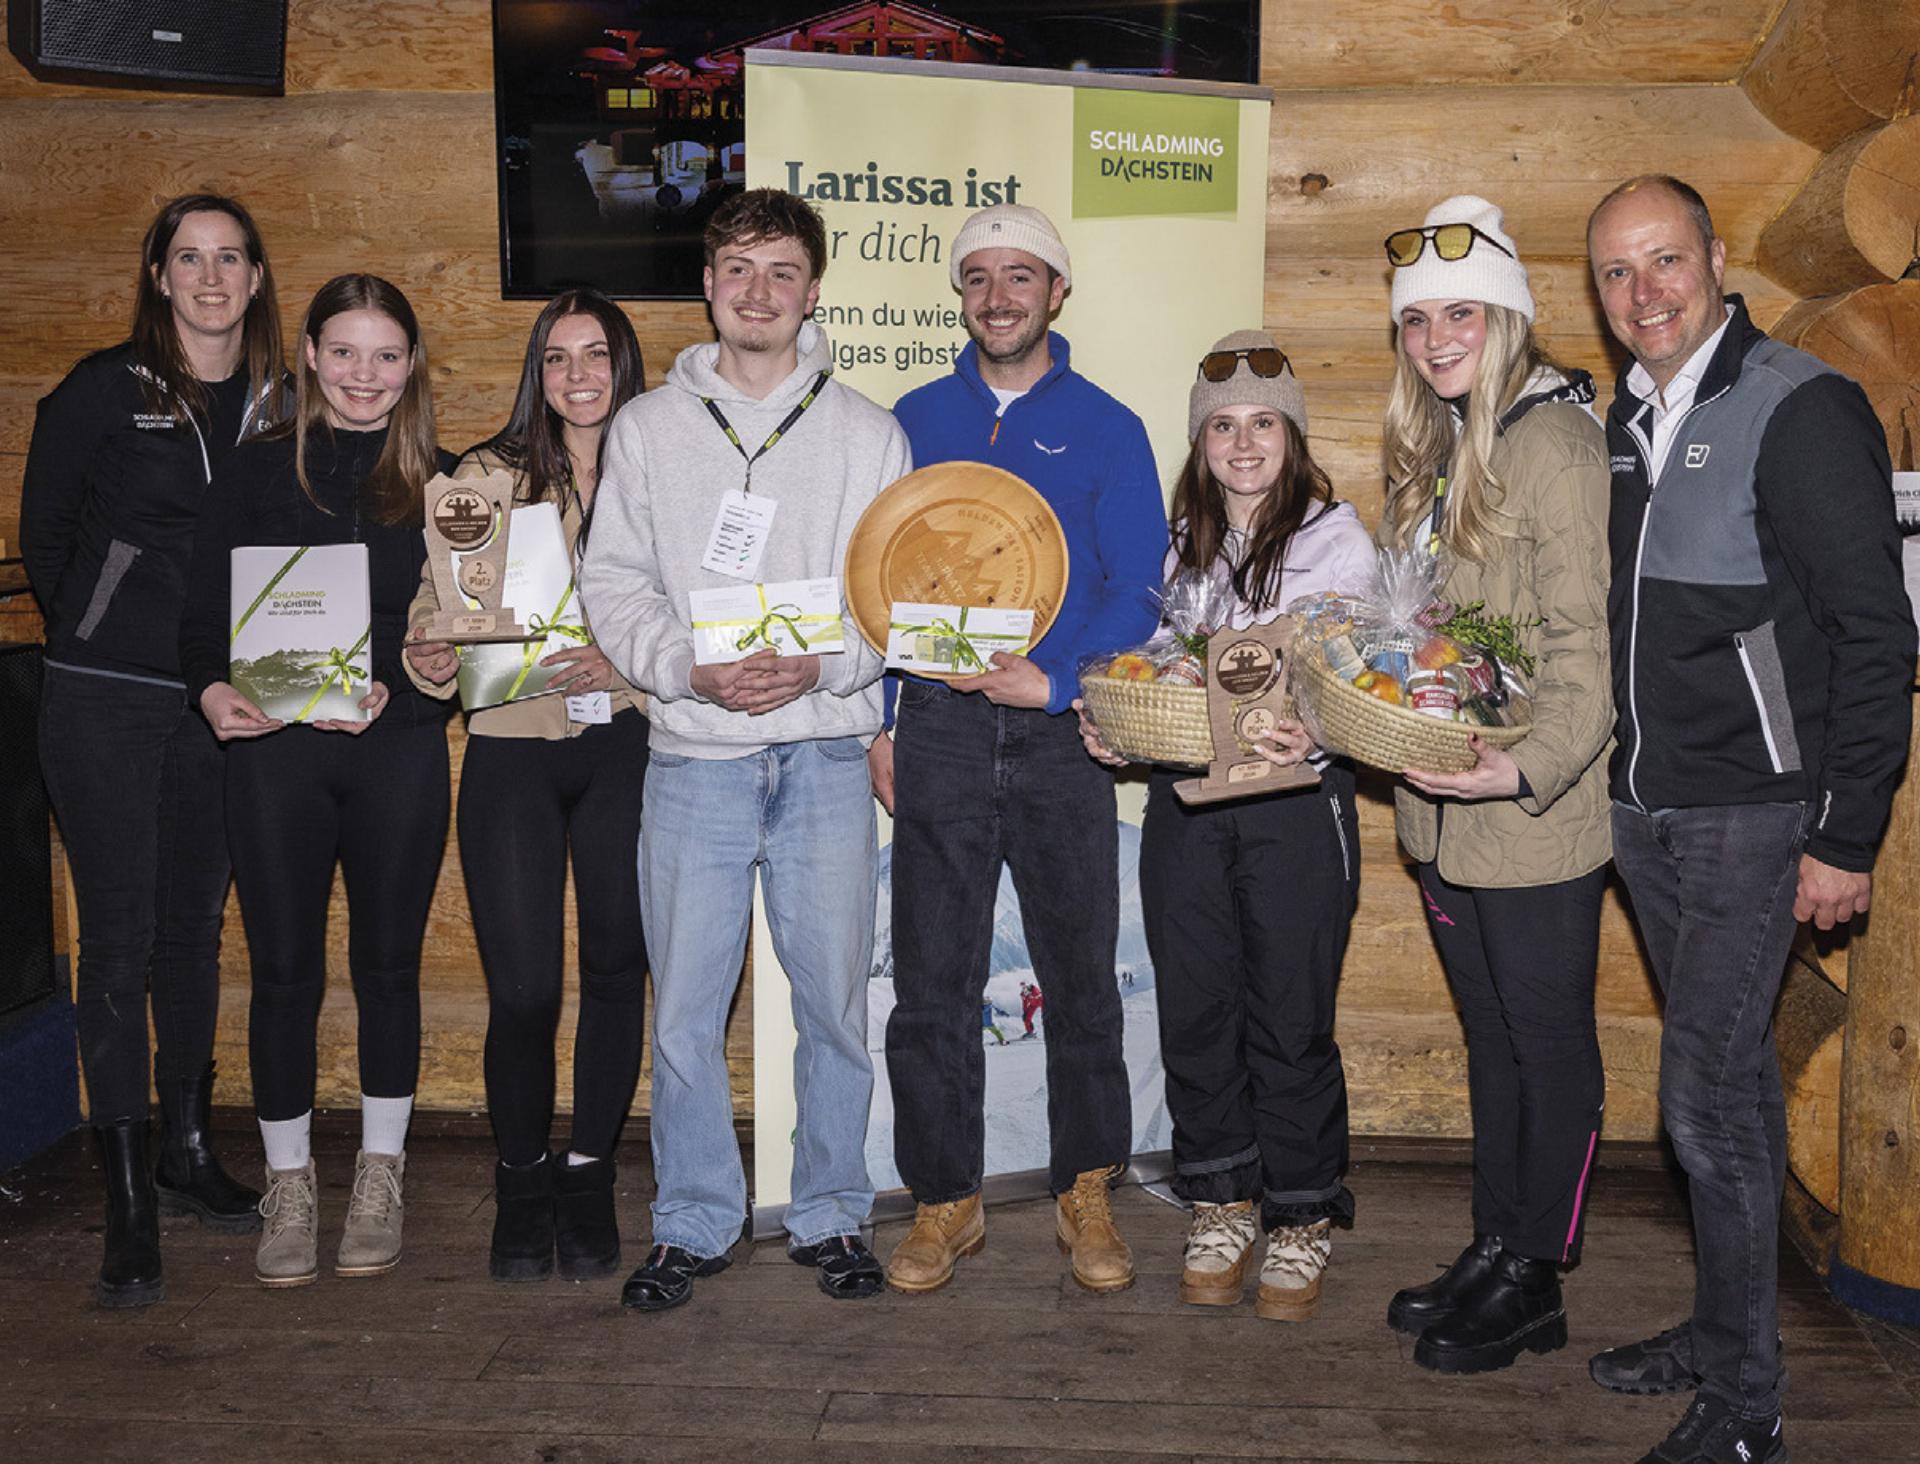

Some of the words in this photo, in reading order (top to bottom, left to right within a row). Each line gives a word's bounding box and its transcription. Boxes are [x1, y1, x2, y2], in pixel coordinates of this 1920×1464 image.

[1090, 130, 1224, 157] SCHLADMING
[1101, 156, 1213, 183] DACHSTEIN
[784, 161, 954, 207] Larissa
[965, 168, 1021, 208] ist
[860, 220, 941, 264] dich
[811, 305, 863, 325] enn
[872, 302, 905, 326] du
[832, 339, 886, 370] lgas
[895, 340, 960, 371] gibst
[468, 576, 491, 587] Platz
[476, 562, 488, 575] 2.
